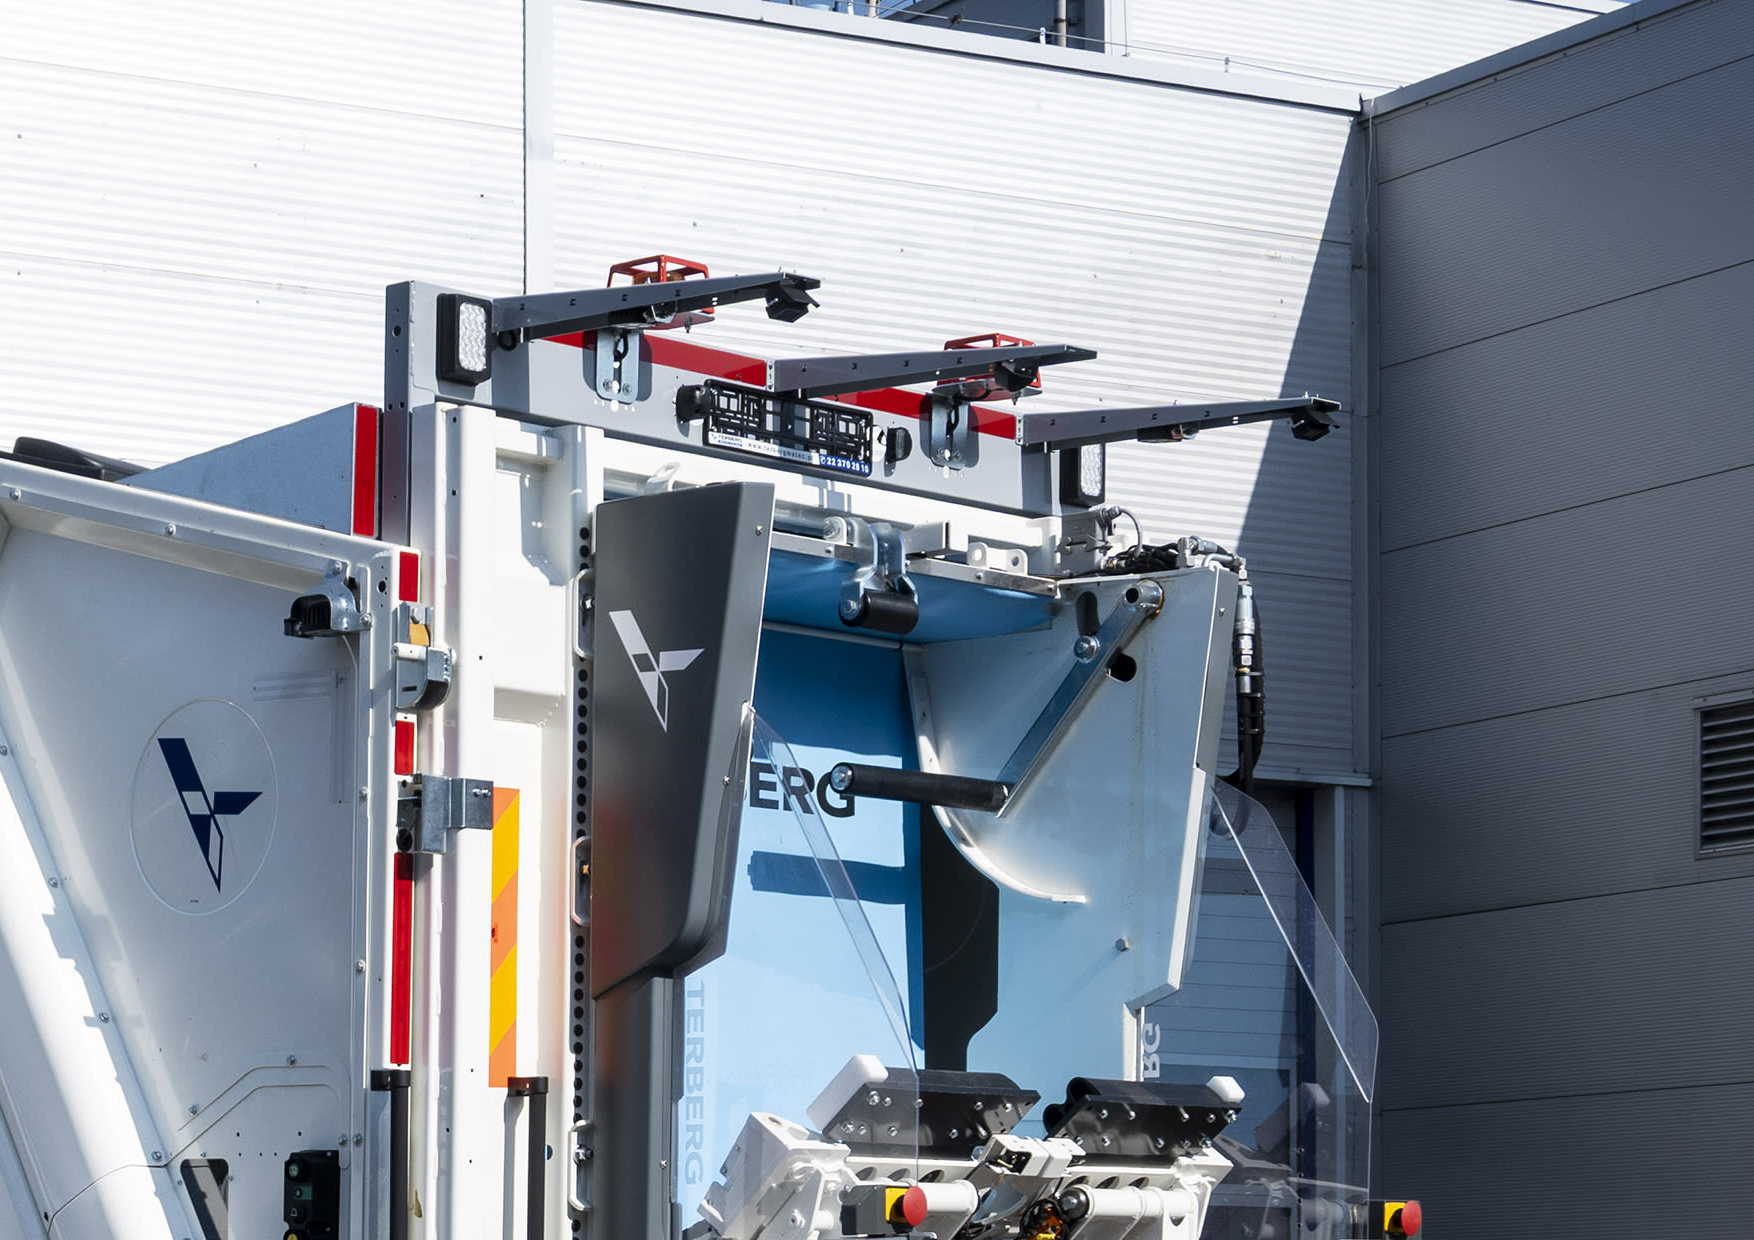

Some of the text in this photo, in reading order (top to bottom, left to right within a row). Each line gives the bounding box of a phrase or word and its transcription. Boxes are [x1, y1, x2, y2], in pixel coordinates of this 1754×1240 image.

[826, 456, 869, 473] 22 370 28 10
[685, 979, 705, 1185] TERBERG
